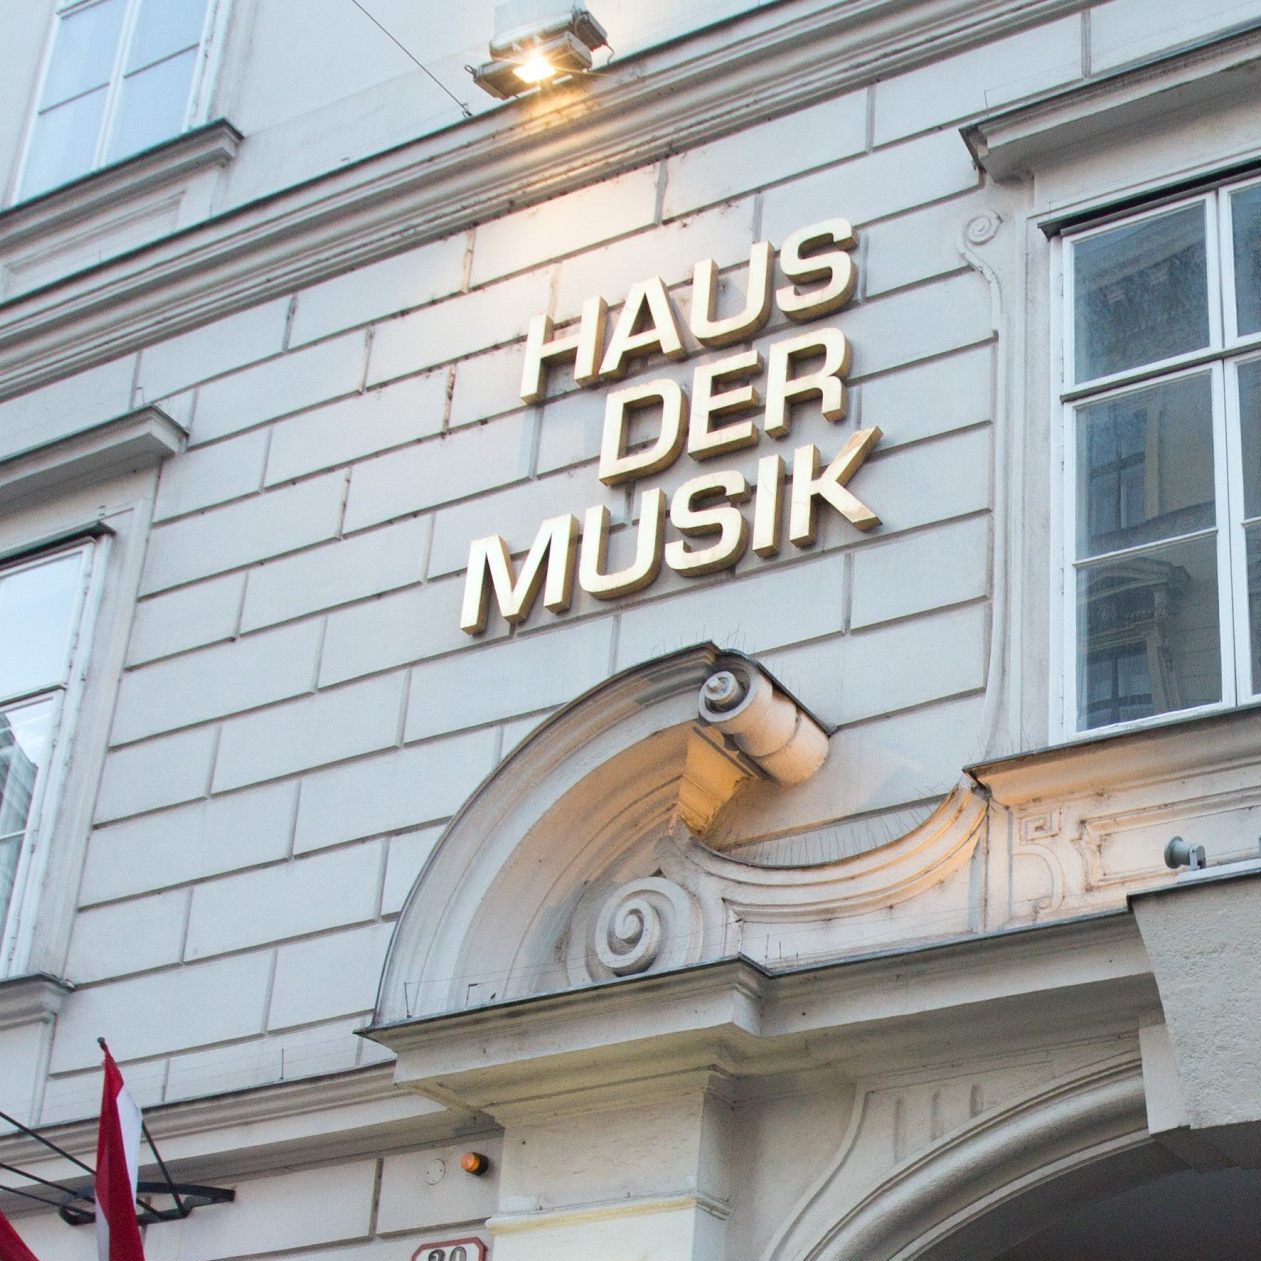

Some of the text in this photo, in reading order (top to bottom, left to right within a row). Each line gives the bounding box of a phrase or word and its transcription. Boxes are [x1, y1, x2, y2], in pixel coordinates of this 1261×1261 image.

[520, 217, 859, 405] HAUS
[599, 327, 852, 487] DER
[460, 426, 884, 635] MUSIK
